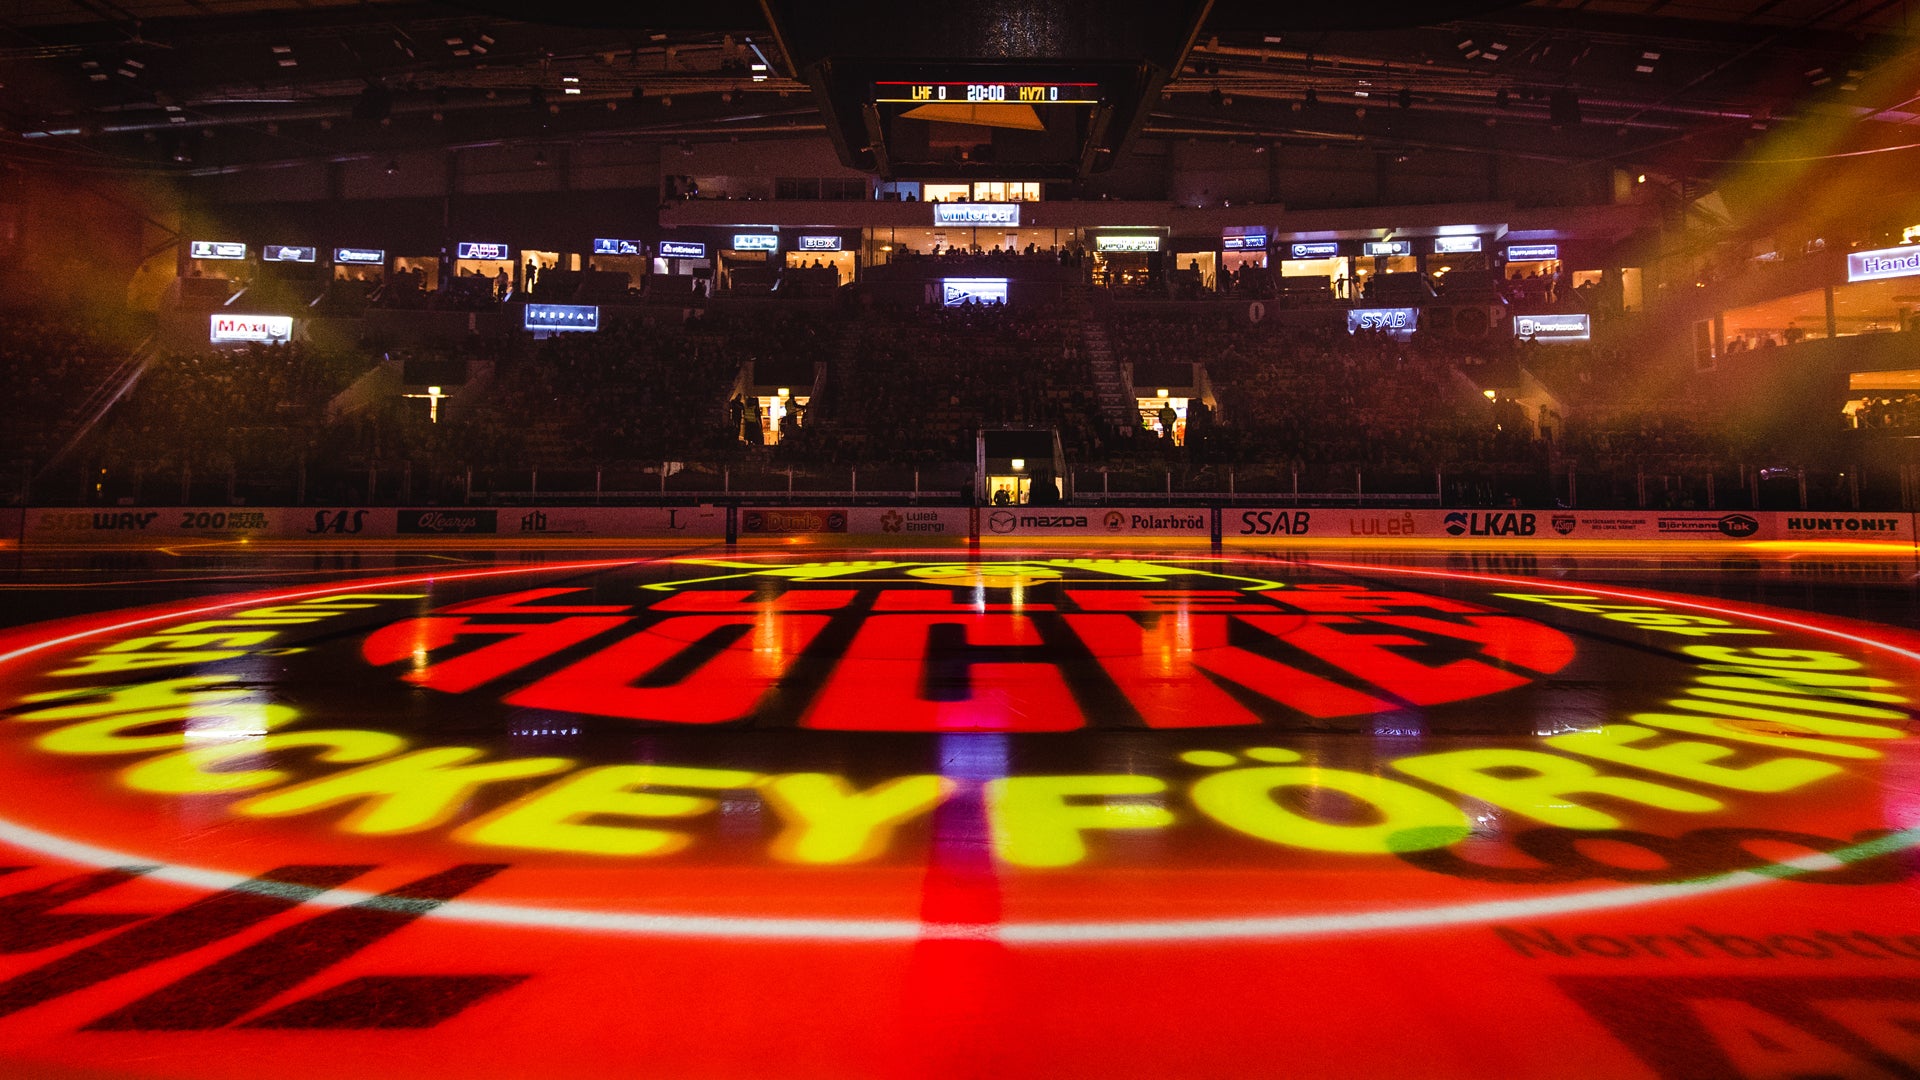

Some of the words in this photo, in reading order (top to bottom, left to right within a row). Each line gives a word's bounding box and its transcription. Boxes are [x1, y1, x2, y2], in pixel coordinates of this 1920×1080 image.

[912, 86, 933, 100] LHF
[938, 86, 946, 100] 0
[967, 85, 1005, 100] 20:00
[1019, 87, 1045, 101] HV71
[1050, 87, 1058, 101] 0
[468, 244, 499, 258] ABB
[218, 320, 267, 333] MAXI
[1361, 312, 1407, 328] SSAB
[38, 512, 158, 529] SUBWAY
[180, 512, 225, 528] 200
[228, 512, 264, 521] METER
[227, 520, 268, 529] HOCKEY
[306, 510, 370, 534] SAS
[767, 511, 822, 532] Dumle
[906, 522, 944, 532] Energi
[1131, 514, 1204, 529] Polarbröd
[1240, 511, 1310, 535] SSAB
[1470, 513, 1536, 536] LKAB
[1658, 521, 1718, 531] Björkmans
[1726, 521, 1750, 532] Tak
[1788, 518, 1898, 531] HUNTONIT
[362, 614, 1577, 733] HOCKEY
